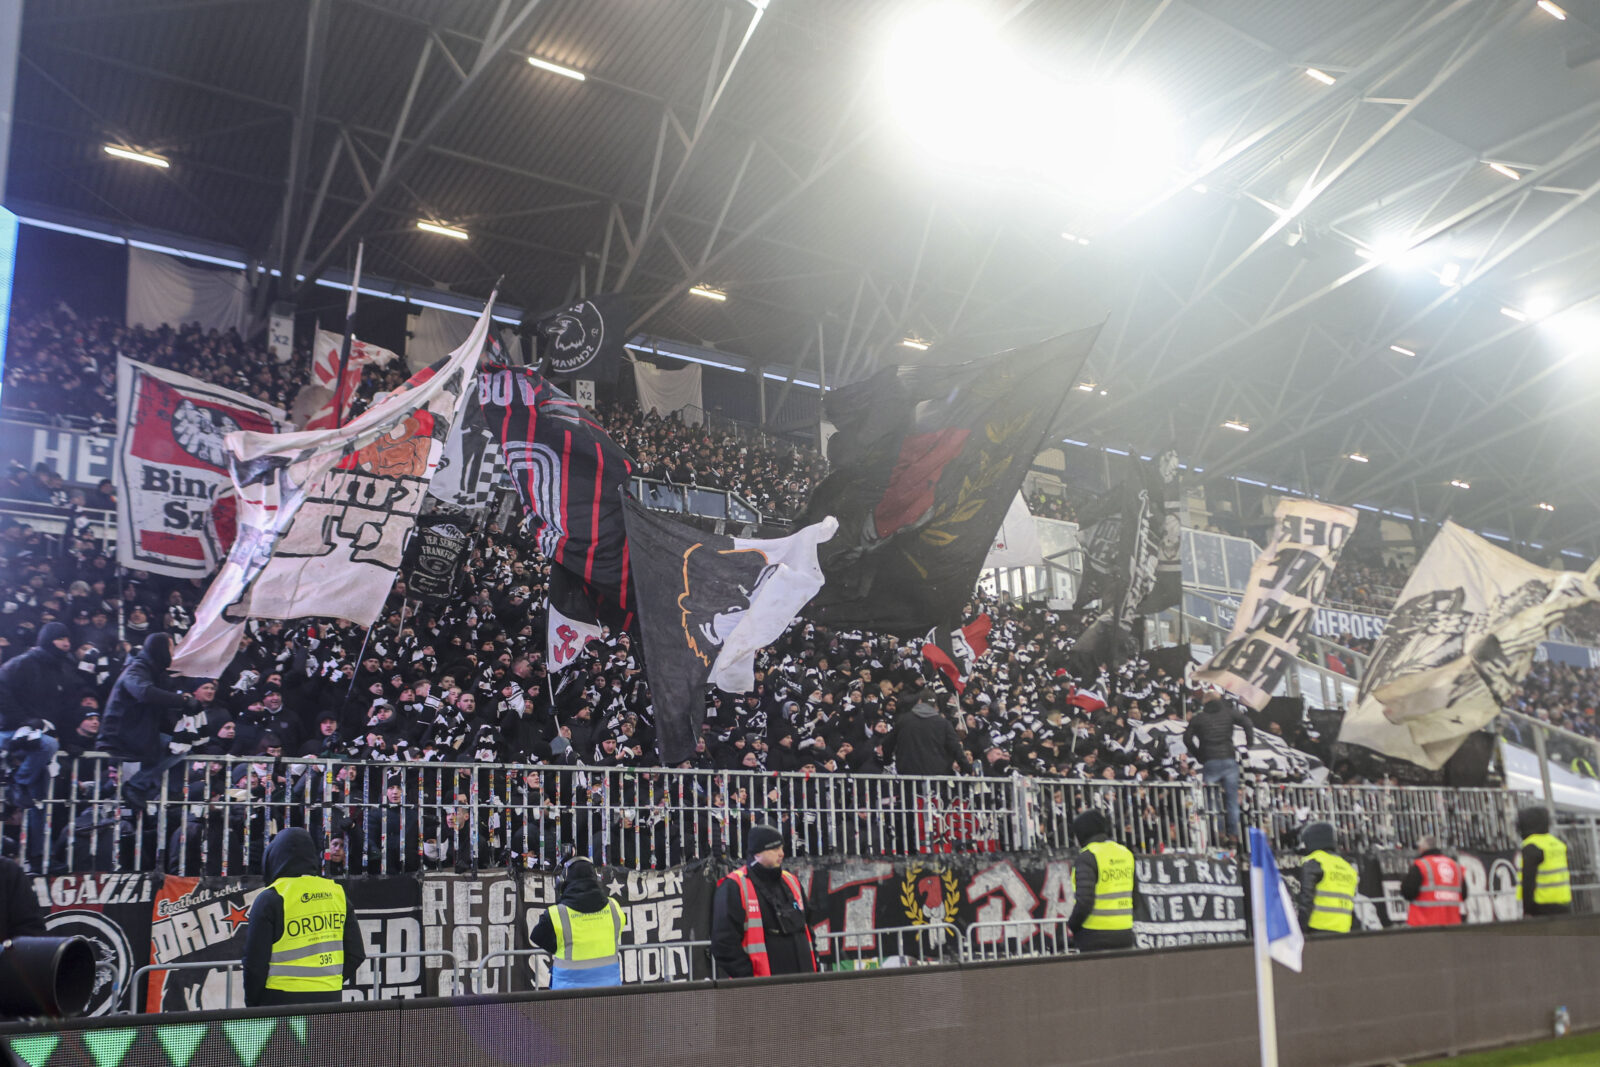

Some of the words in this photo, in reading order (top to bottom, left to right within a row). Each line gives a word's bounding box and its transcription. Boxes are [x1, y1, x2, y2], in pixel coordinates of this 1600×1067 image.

[31, 429, 117, 486] HE
[1135, 858, 1238, 884] ULTRAS
[158, 892, 211, 917] Football
[422, 880, 517, 925] REG
[1148, 895, 1236, 922] NEVER
